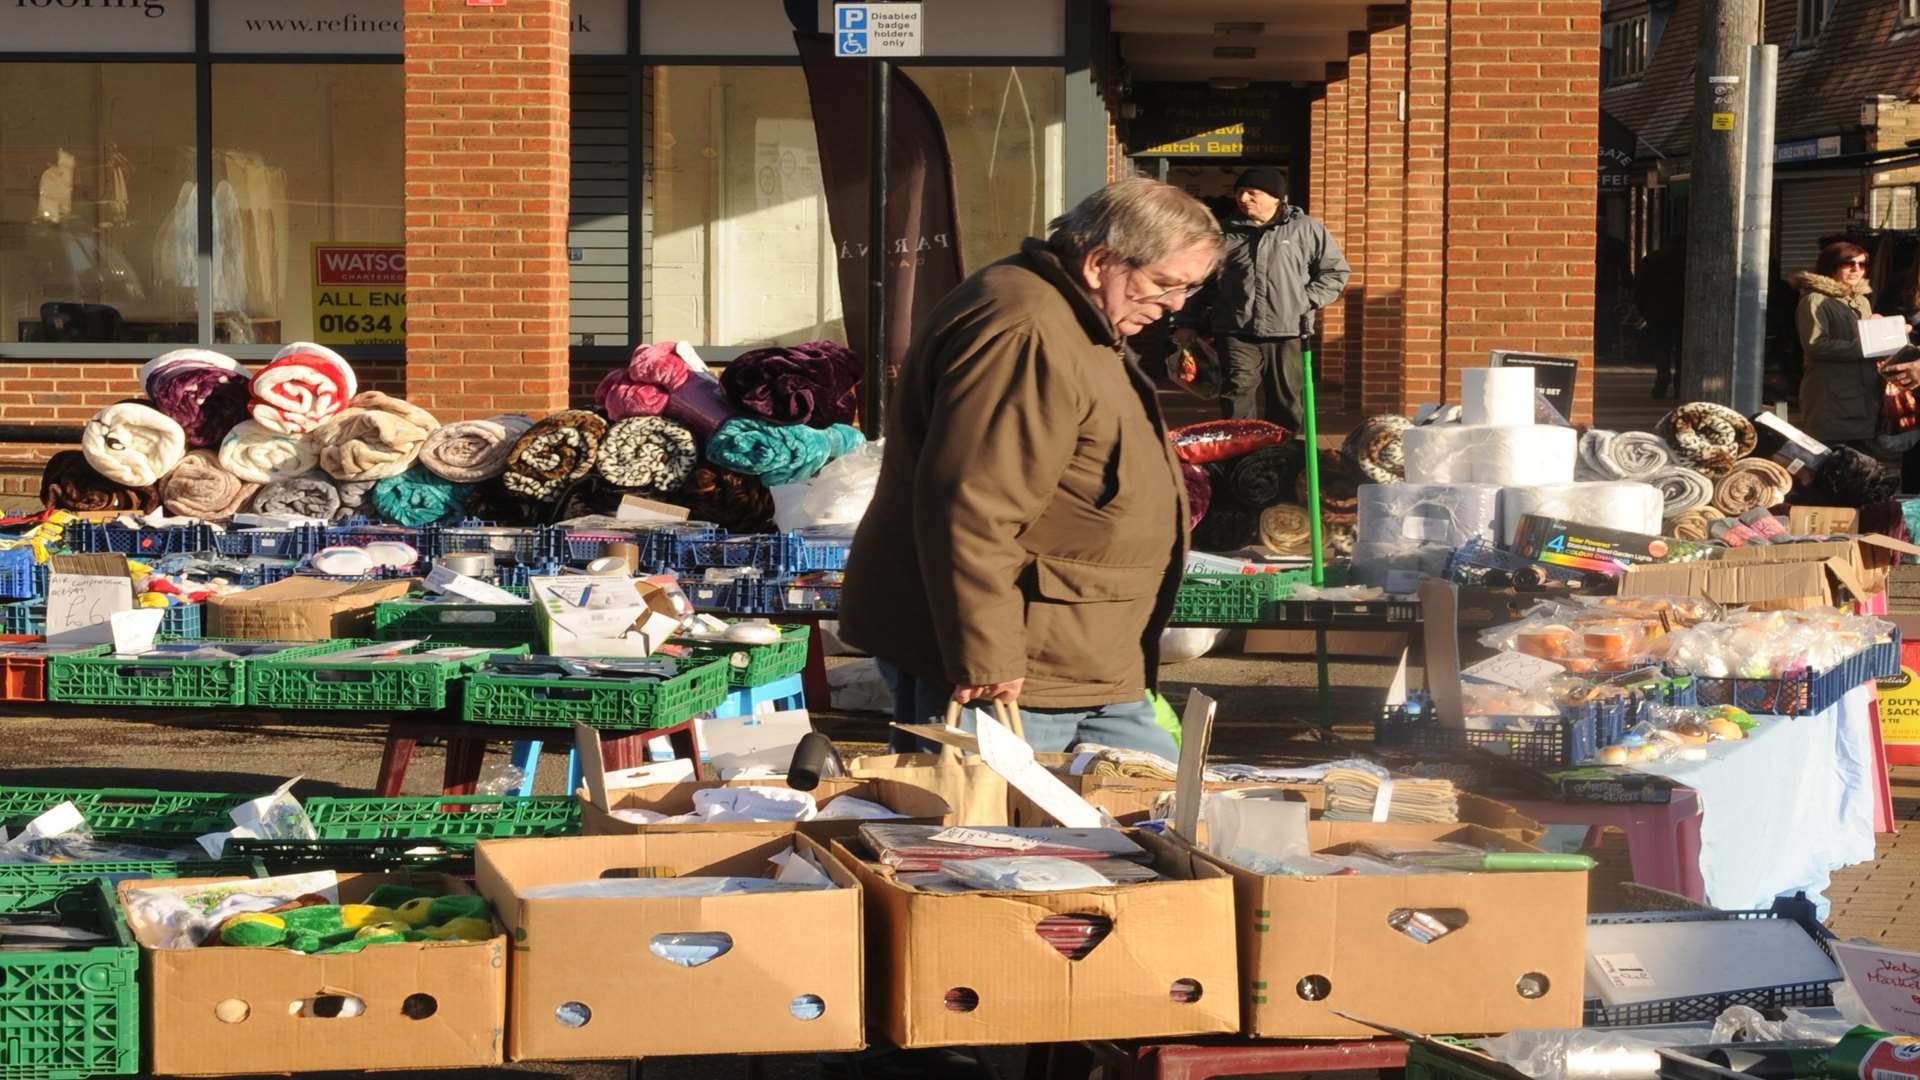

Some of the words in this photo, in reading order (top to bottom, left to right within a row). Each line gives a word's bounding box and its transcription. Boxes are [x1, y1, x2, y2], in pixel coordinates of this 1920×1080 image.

[871, 12, 917, 20] Disabled
[878, 22, 910, 30] badge
[882, 39, 905, 47] only
[319, 291, 362, 306] ALL
[319, 314, 392, 334] 01634
[1545, 534, 1566, 554] 4
[1887, 698, 1920, 706] DUTY
